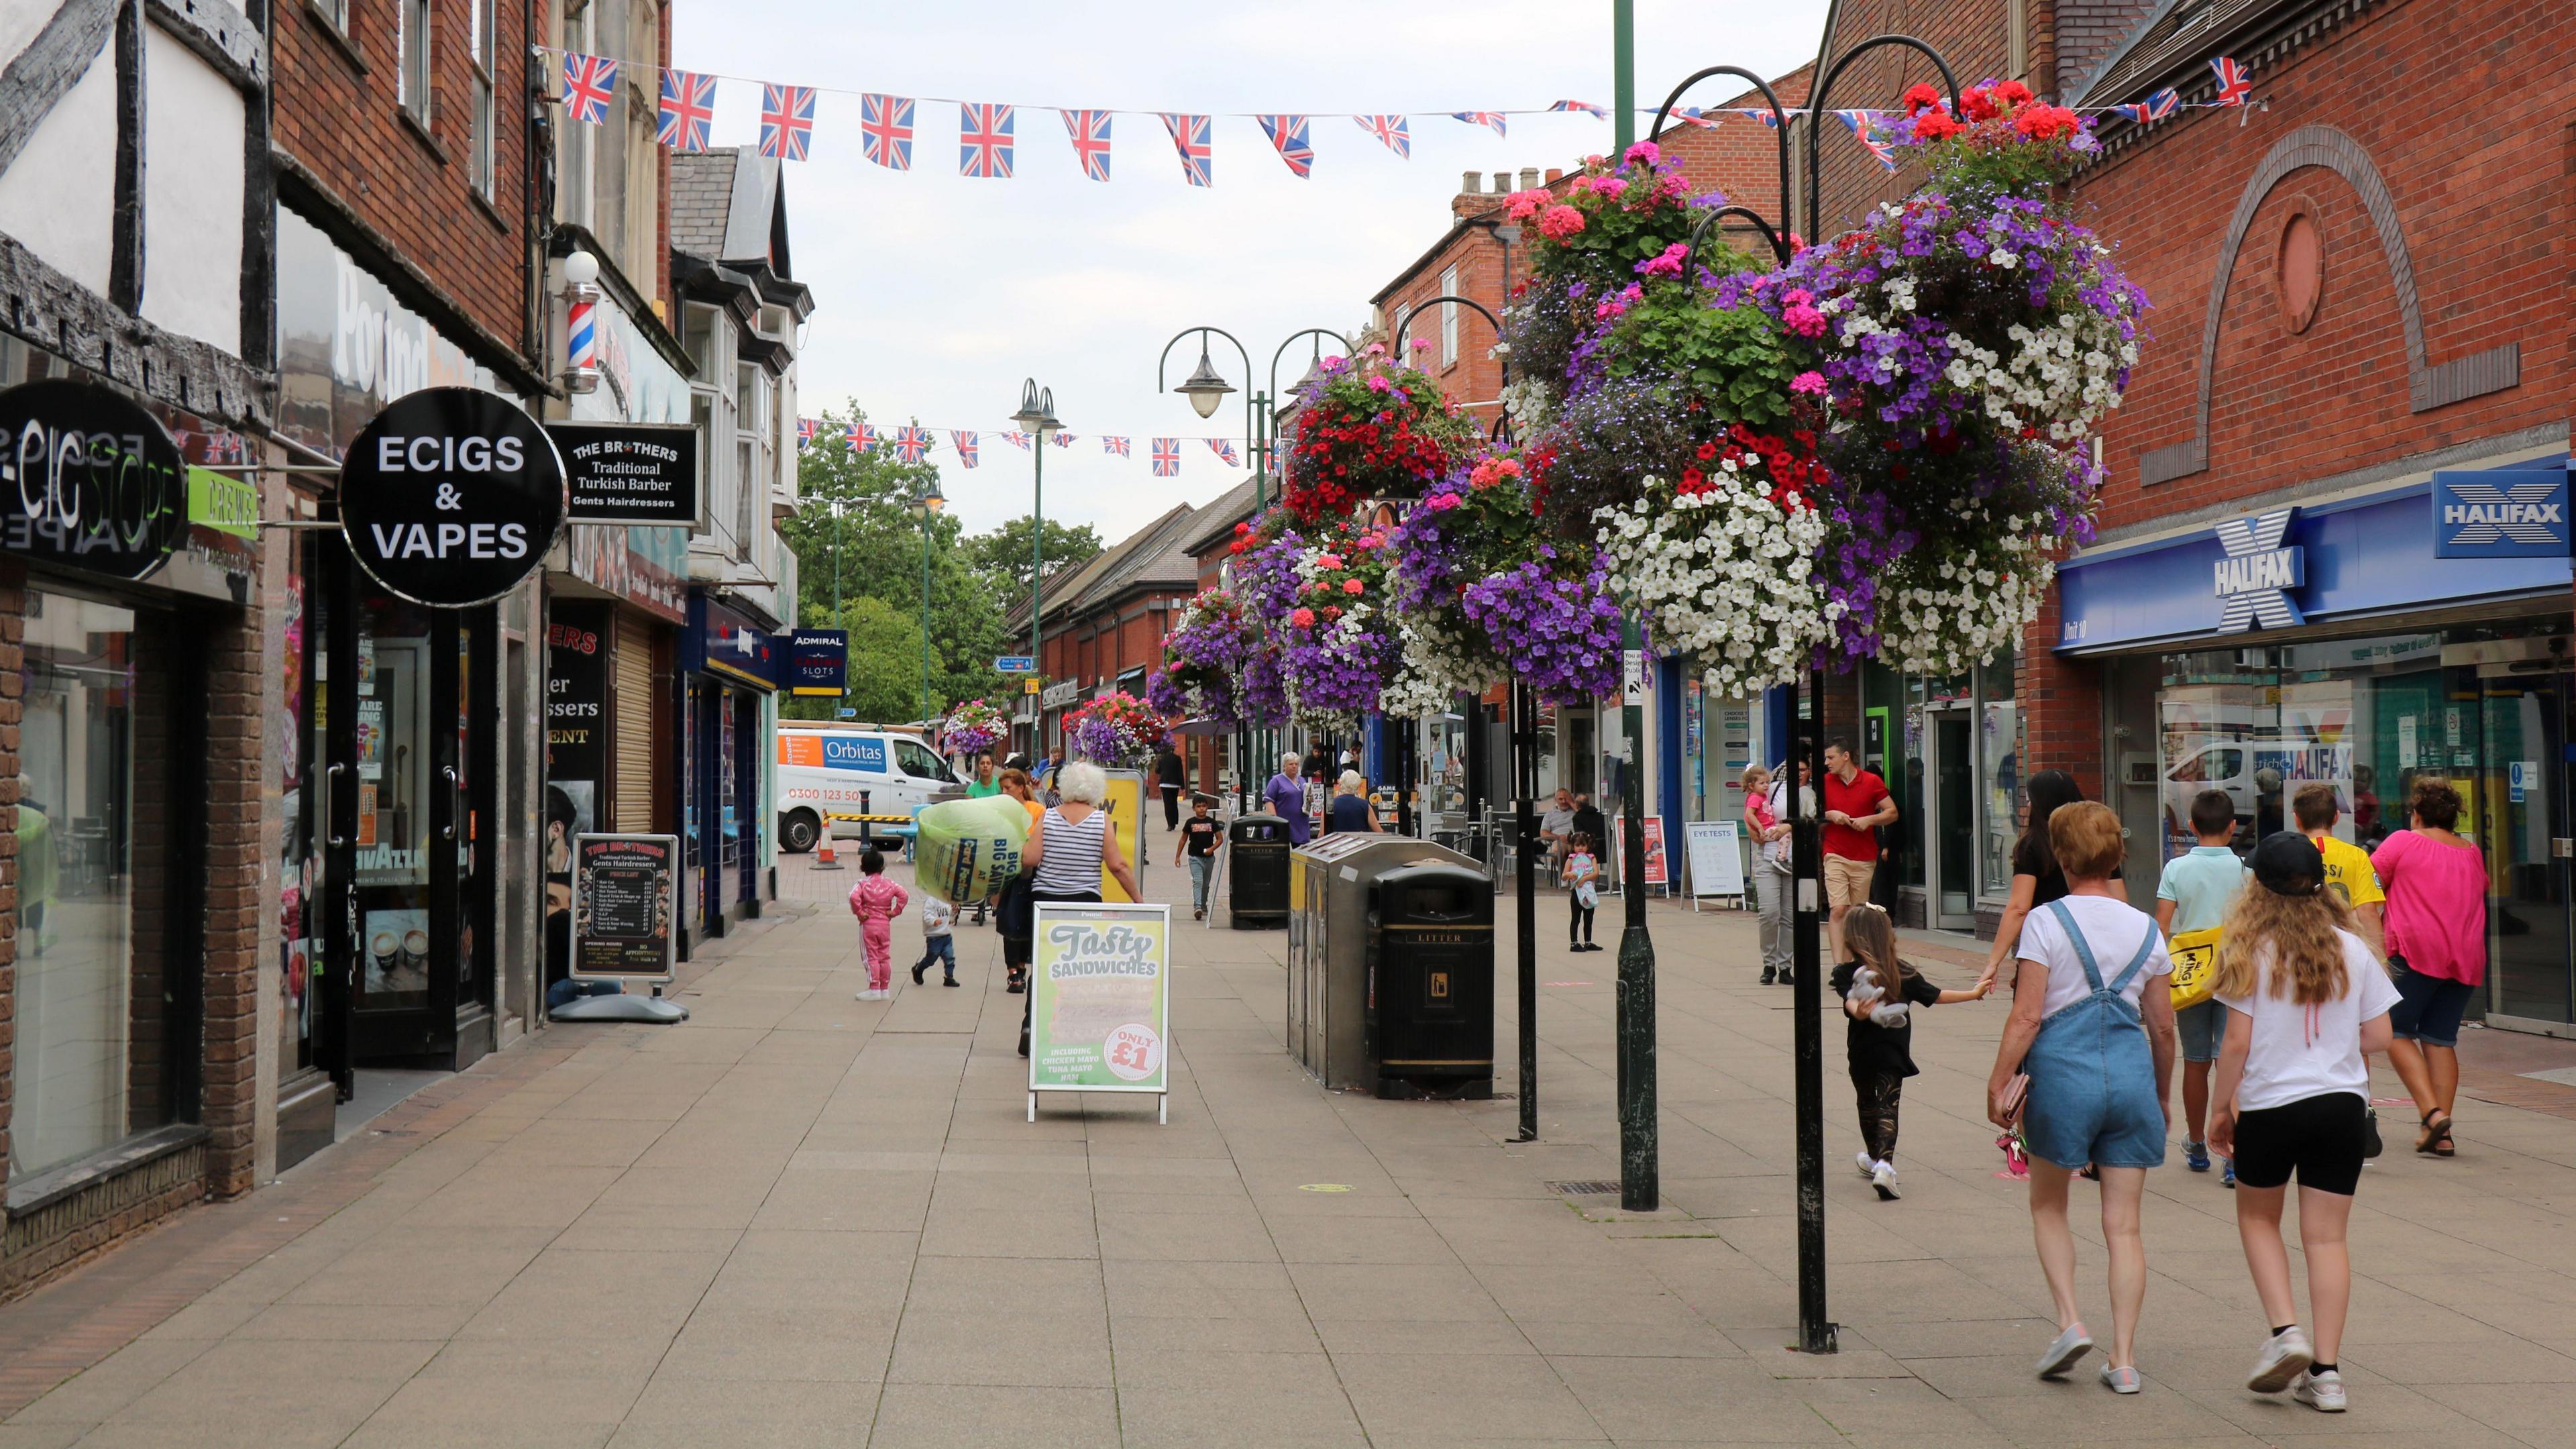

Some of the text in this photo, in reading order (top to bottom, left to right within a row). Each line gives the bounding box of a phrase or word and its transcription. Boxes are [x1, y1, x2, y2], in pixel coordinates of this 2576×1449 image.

[379, 436, 524, 472] ECIGS
[573, 441, 678, 462] THE BRTHERS
[592, 462, 660, 475] Traditional
[578, 477, 671, 491] Turkish Barber
[209, 479, 252, 532] CREWE
[436, 482, 462, 511] &
[573, 496, 675, 507] Gents Hairdressers
[2445, 504, 2563, 524] HALIFAX
[371, 523, 527, 559] VAPES
[2214, 549, 2294, 596] HALIFAX
[2064, 620, 2087, 641] Unit 10
[794, 637, 843, 646] ADMIRAL
[802, 667, 834, 675] SLOTS
[360, 701, 382, 711] ARE
[358, 712, 380, 721] ING
[826, 741, 881, 759] Orbitas
[2282, 748, 2352, 780] HALIFAX
[789, 788, 820, 799] 0300
[823, 790, 841, 800] 123
[586, 841, 665, 859] THE BRTHERS
[992, 839, 1007, 861] BIG
[954, 840, 975, 898] Card Factory
[1006, 851, 1018, 873] BIG
[978, 870, 987, 880] AT
[1051, 925, 1152, 962] Tasty
[1418, 934, 1461, 943] LITTER
[1051, 958, 1156, 978] SANDWICHES
[2181, 953, 2196, 981] KING
[1118, 1031, 1154, 1047] ONLY
[1051, 1048, 1091, 1056] INCLUDING
[1077, 1055, 1099, 1063] MAYO
[1112, 1042, 1148, 1071] £1
[1061, 1073, 1079, 1081] HAM
